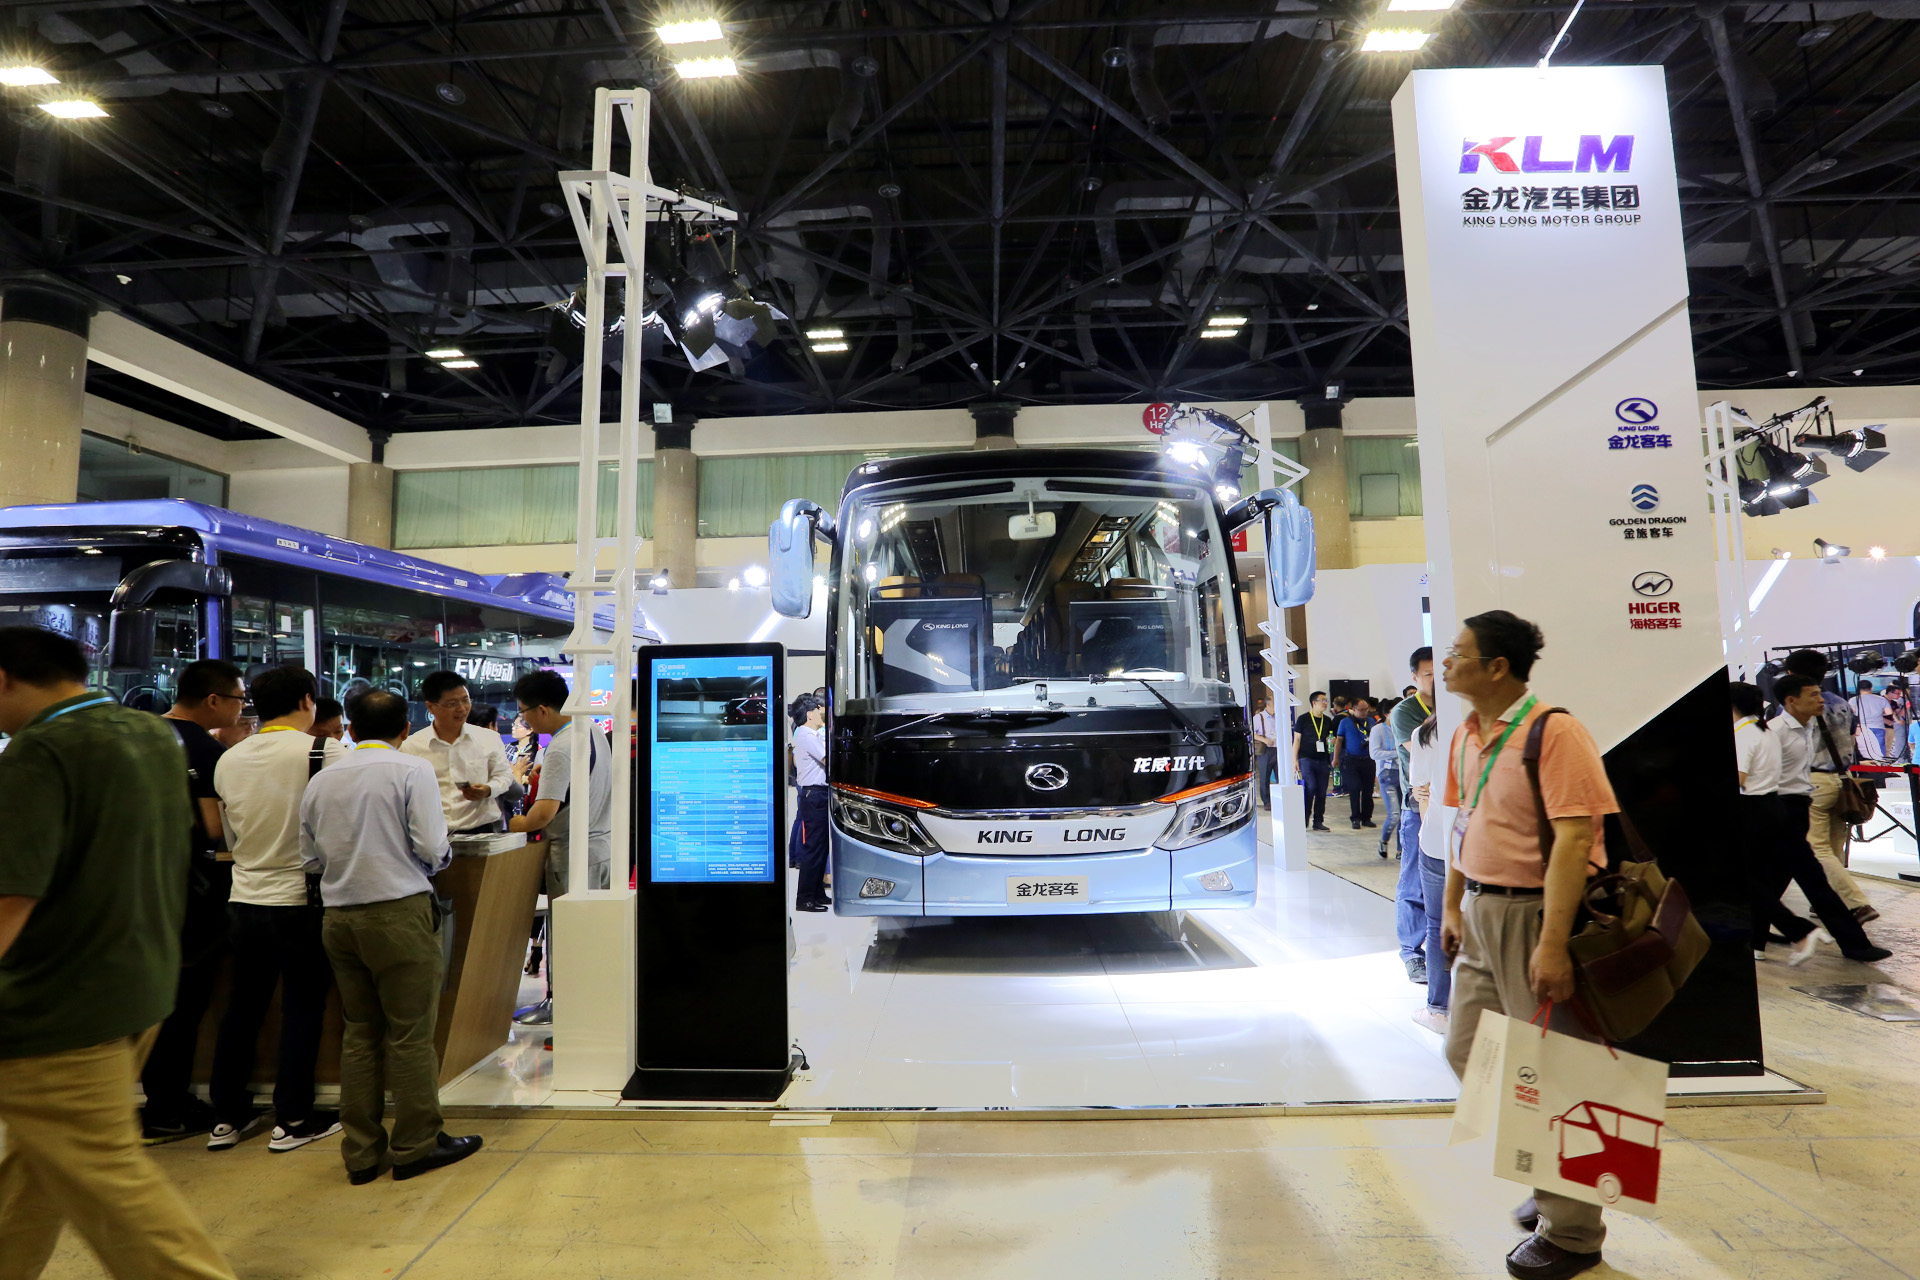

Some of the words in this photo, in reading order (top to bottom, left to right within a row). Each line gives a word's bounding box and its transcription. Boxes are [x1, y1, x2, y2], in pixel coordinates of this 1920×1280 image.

[1459, 134, 1635, 174] KLM
[1461, 185, 1640, 212] 金龙汽车集团
[1462, 216, 1496, 227] KING
[1500, 216, 1538, 227] LONG
[1542, 215, 1590, 227] MOTOR
[1594, 214, 1642, 226] GROUP
[1149, 407, 1169, 420] 12
[1608, 434, 1672, 449] 金龙客车
[1609, 518, 1647, 526] GOLDEN
[1648, 516, 1687, 525] DRAGON
[1623, 527, 1674, 539] 金旅客车
[1628, 602, 1681, 614] HIGER
[1630, 618, 1682, 630] 海格客车
[455, 658, 482, 680] EV
[481, 659, 514, 682] 纯电动
[977, 829, 1033, 844] KING
[1063, 827, 1126, 842] LONG
[1016, 883, 1079, 897] 金龙客车
